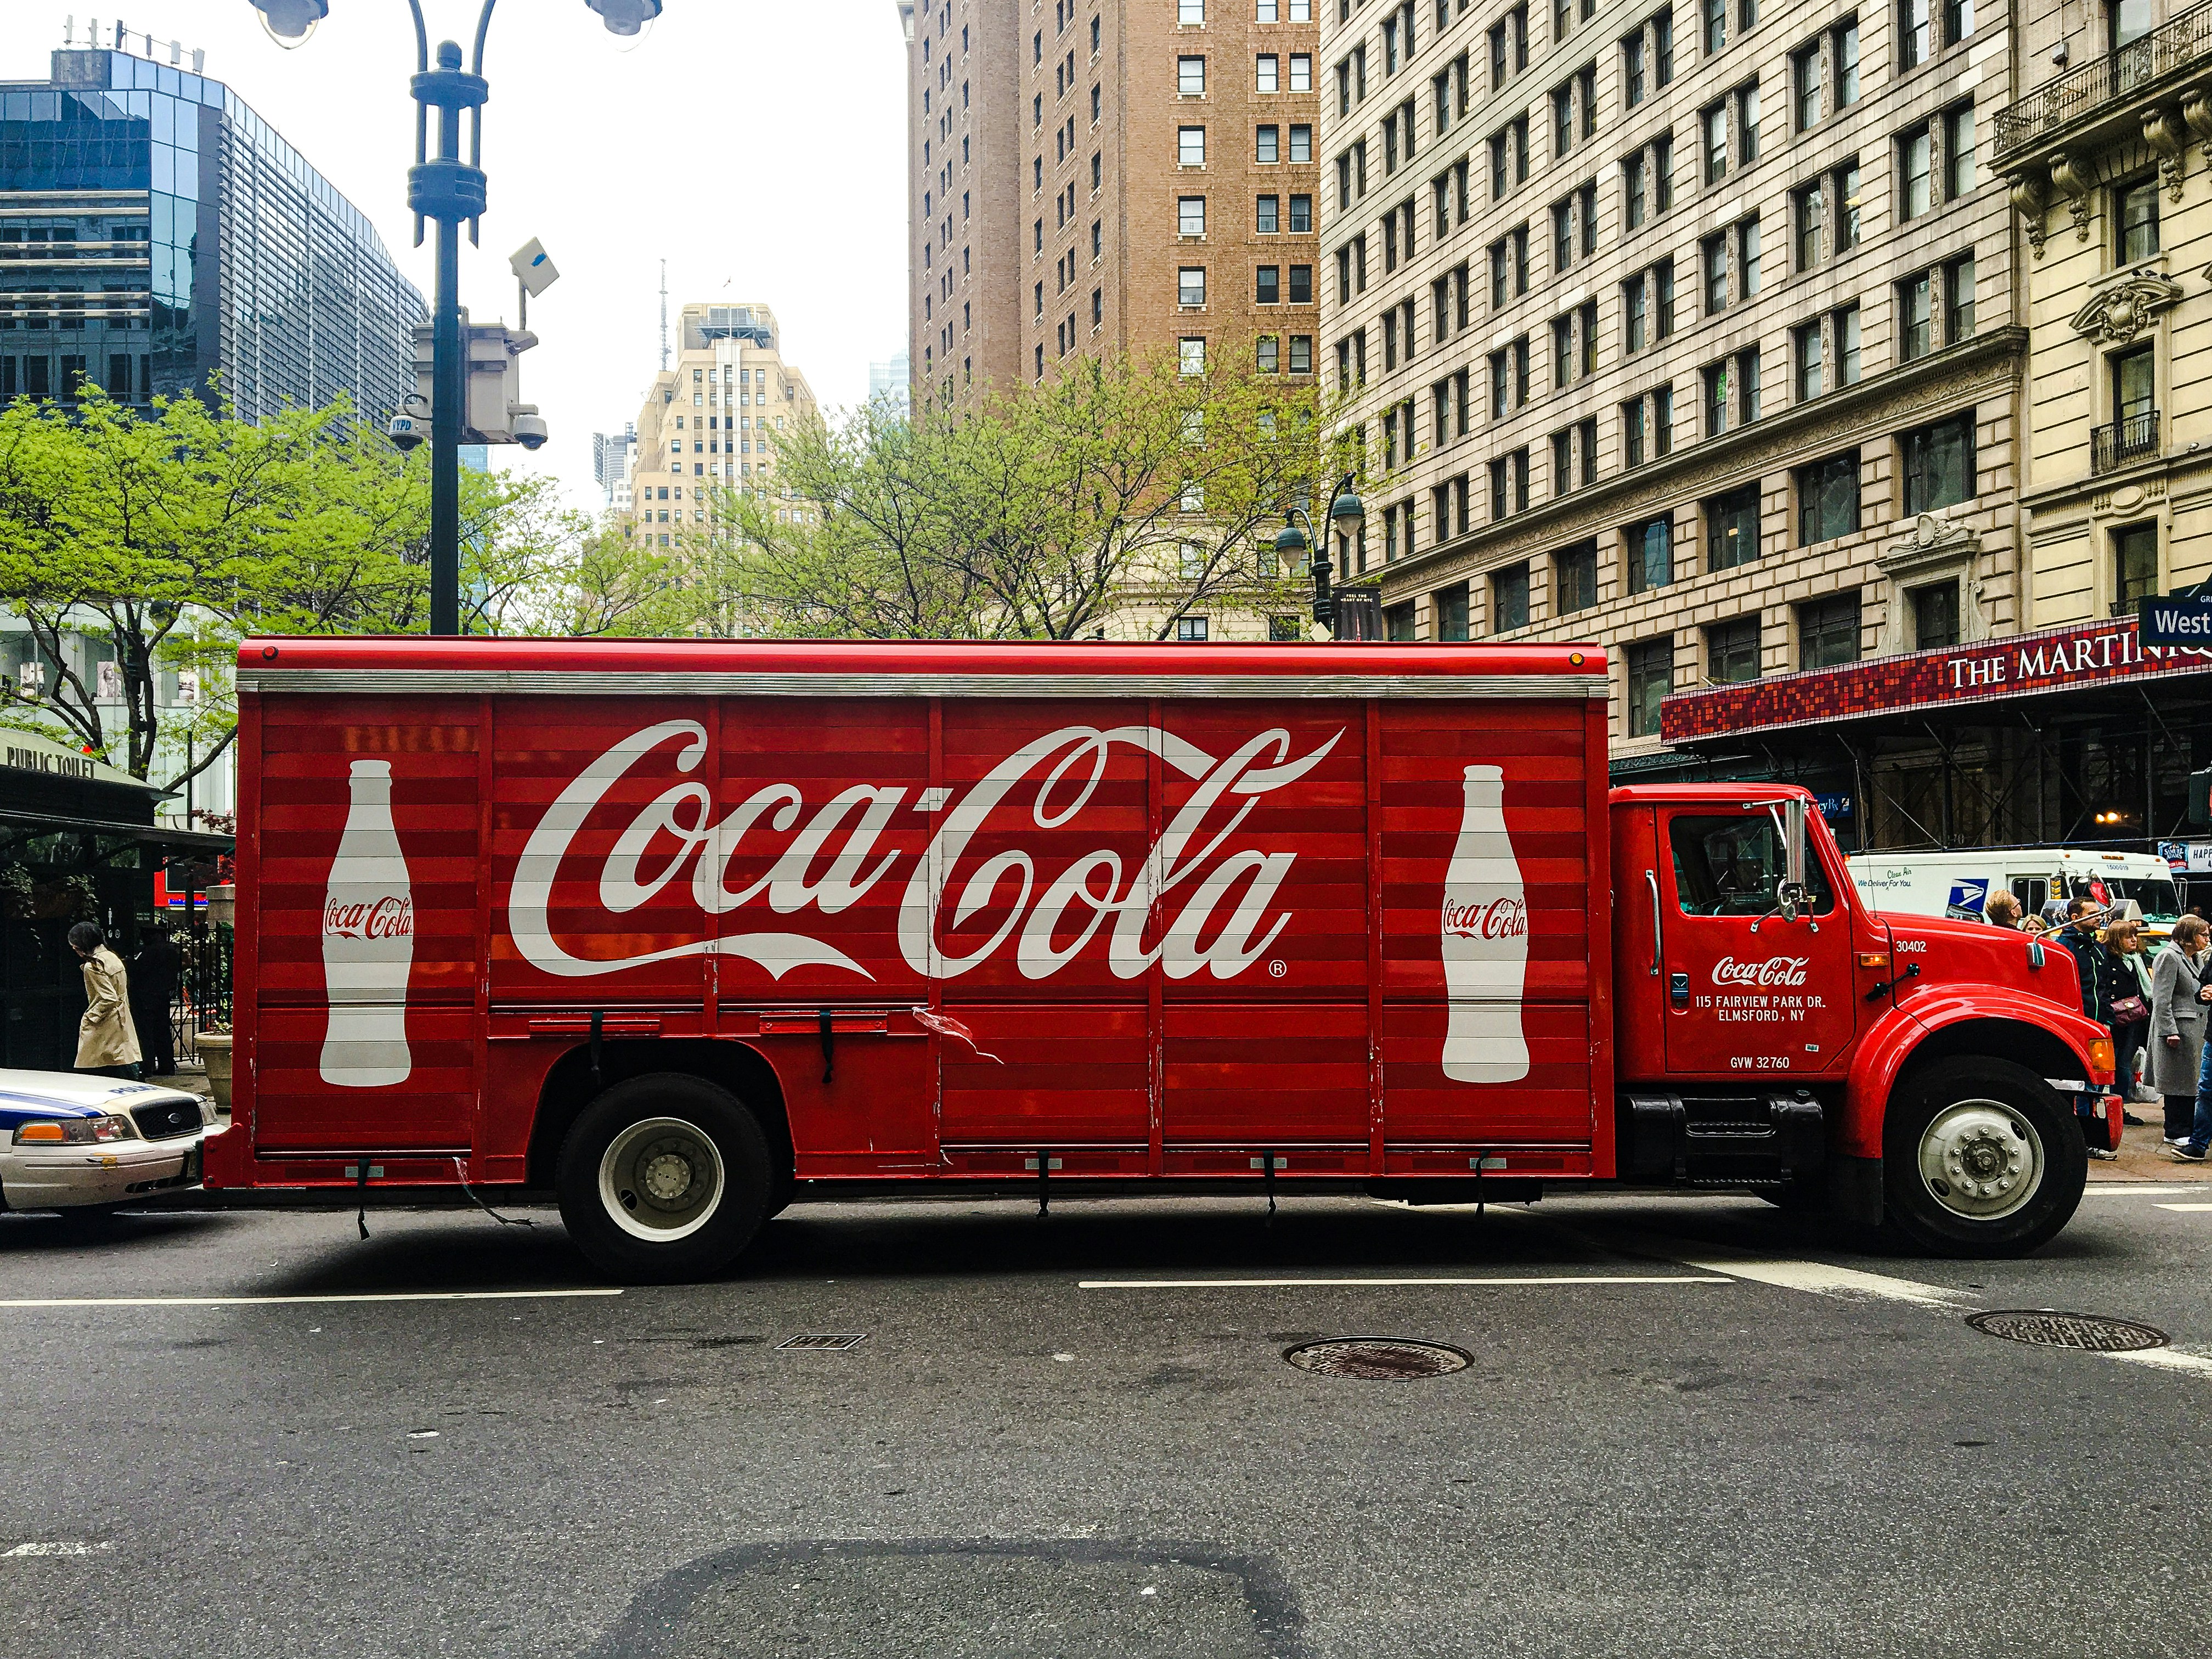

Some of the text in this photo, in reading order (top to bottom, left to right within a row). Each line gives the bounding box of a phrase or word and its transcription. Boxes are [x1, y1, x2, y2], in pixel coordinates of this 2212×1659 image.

[2154, 610, 2210, 634] West
[1948, 656, 2006, 689] THE
[7, 746, 96, 779] PUBLIC TOILET
[509, 719, 1347, 981] Coca-Cola
[2166, 852, 2182, 860] ADAMS
[1887, 867, 1912, 879] Clean Air
[325, 896, 411, 940] Coca-Cola
[1443, 897, 1525, 940] Coca-Cola
[1896, 940, 1927, 952] 30402
[1712, 956, 1810, 986] Coca-Cola
[1696, 996, 1826, 1008] 115 FAIRVIEW PARK DR.
[1791, 1009, 1805, 1021] NY
[1730, 1057, 1790, 1068] GVW 32760
[108, 1085, 163, 1095] POLIC
